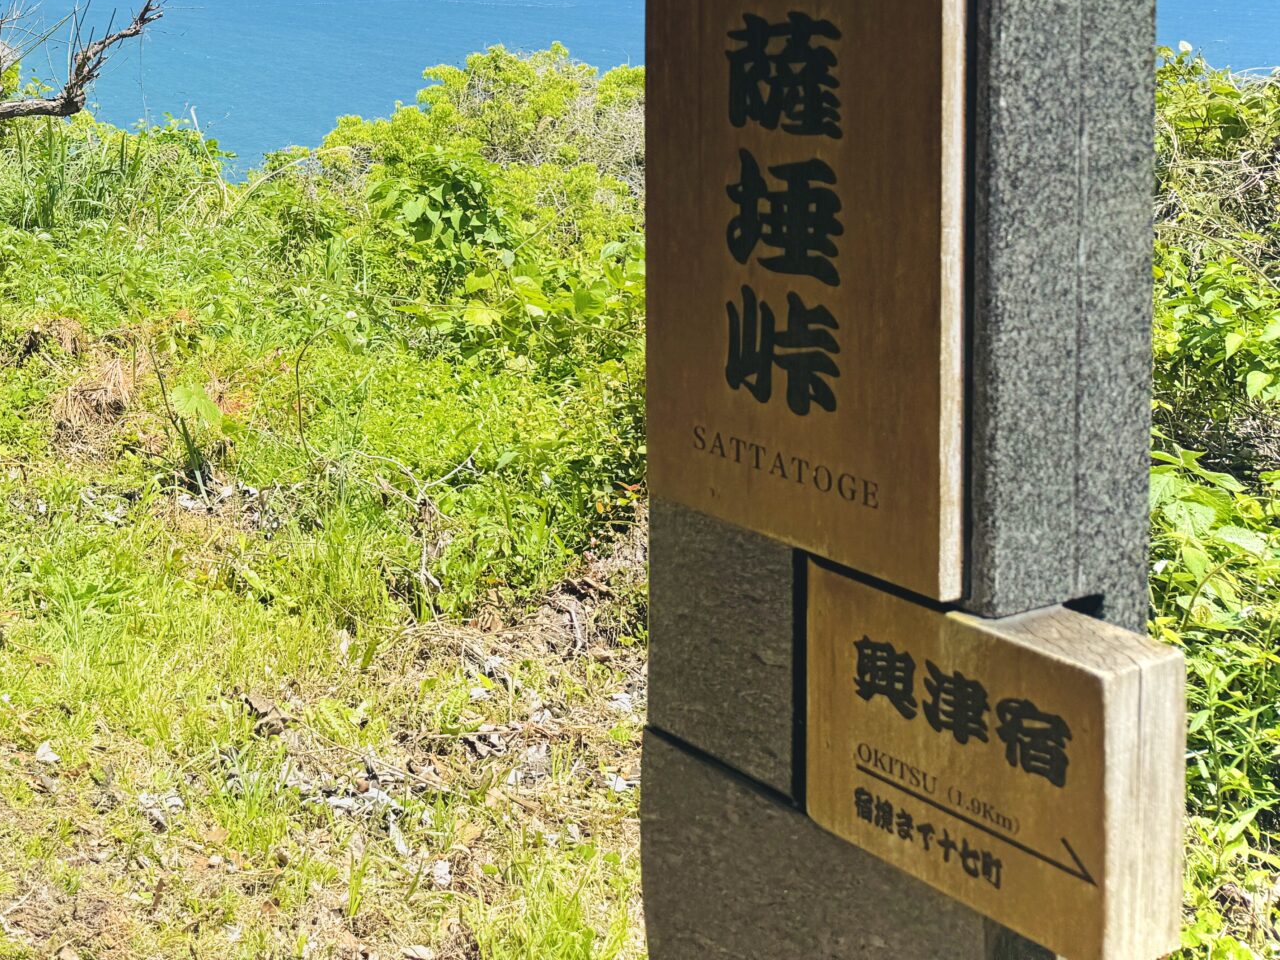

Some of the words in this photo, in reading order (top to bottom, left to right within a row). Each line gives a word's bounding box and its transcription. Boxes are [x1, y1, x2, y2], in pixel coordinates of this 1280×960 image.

[693, 425, 880, 509] SATTATOGE
[853, 634, 1073, 789] 興津宿
[856, 742, 938, 795] OKITSU
[947, 785, 1021, 836] (1.9Km)
